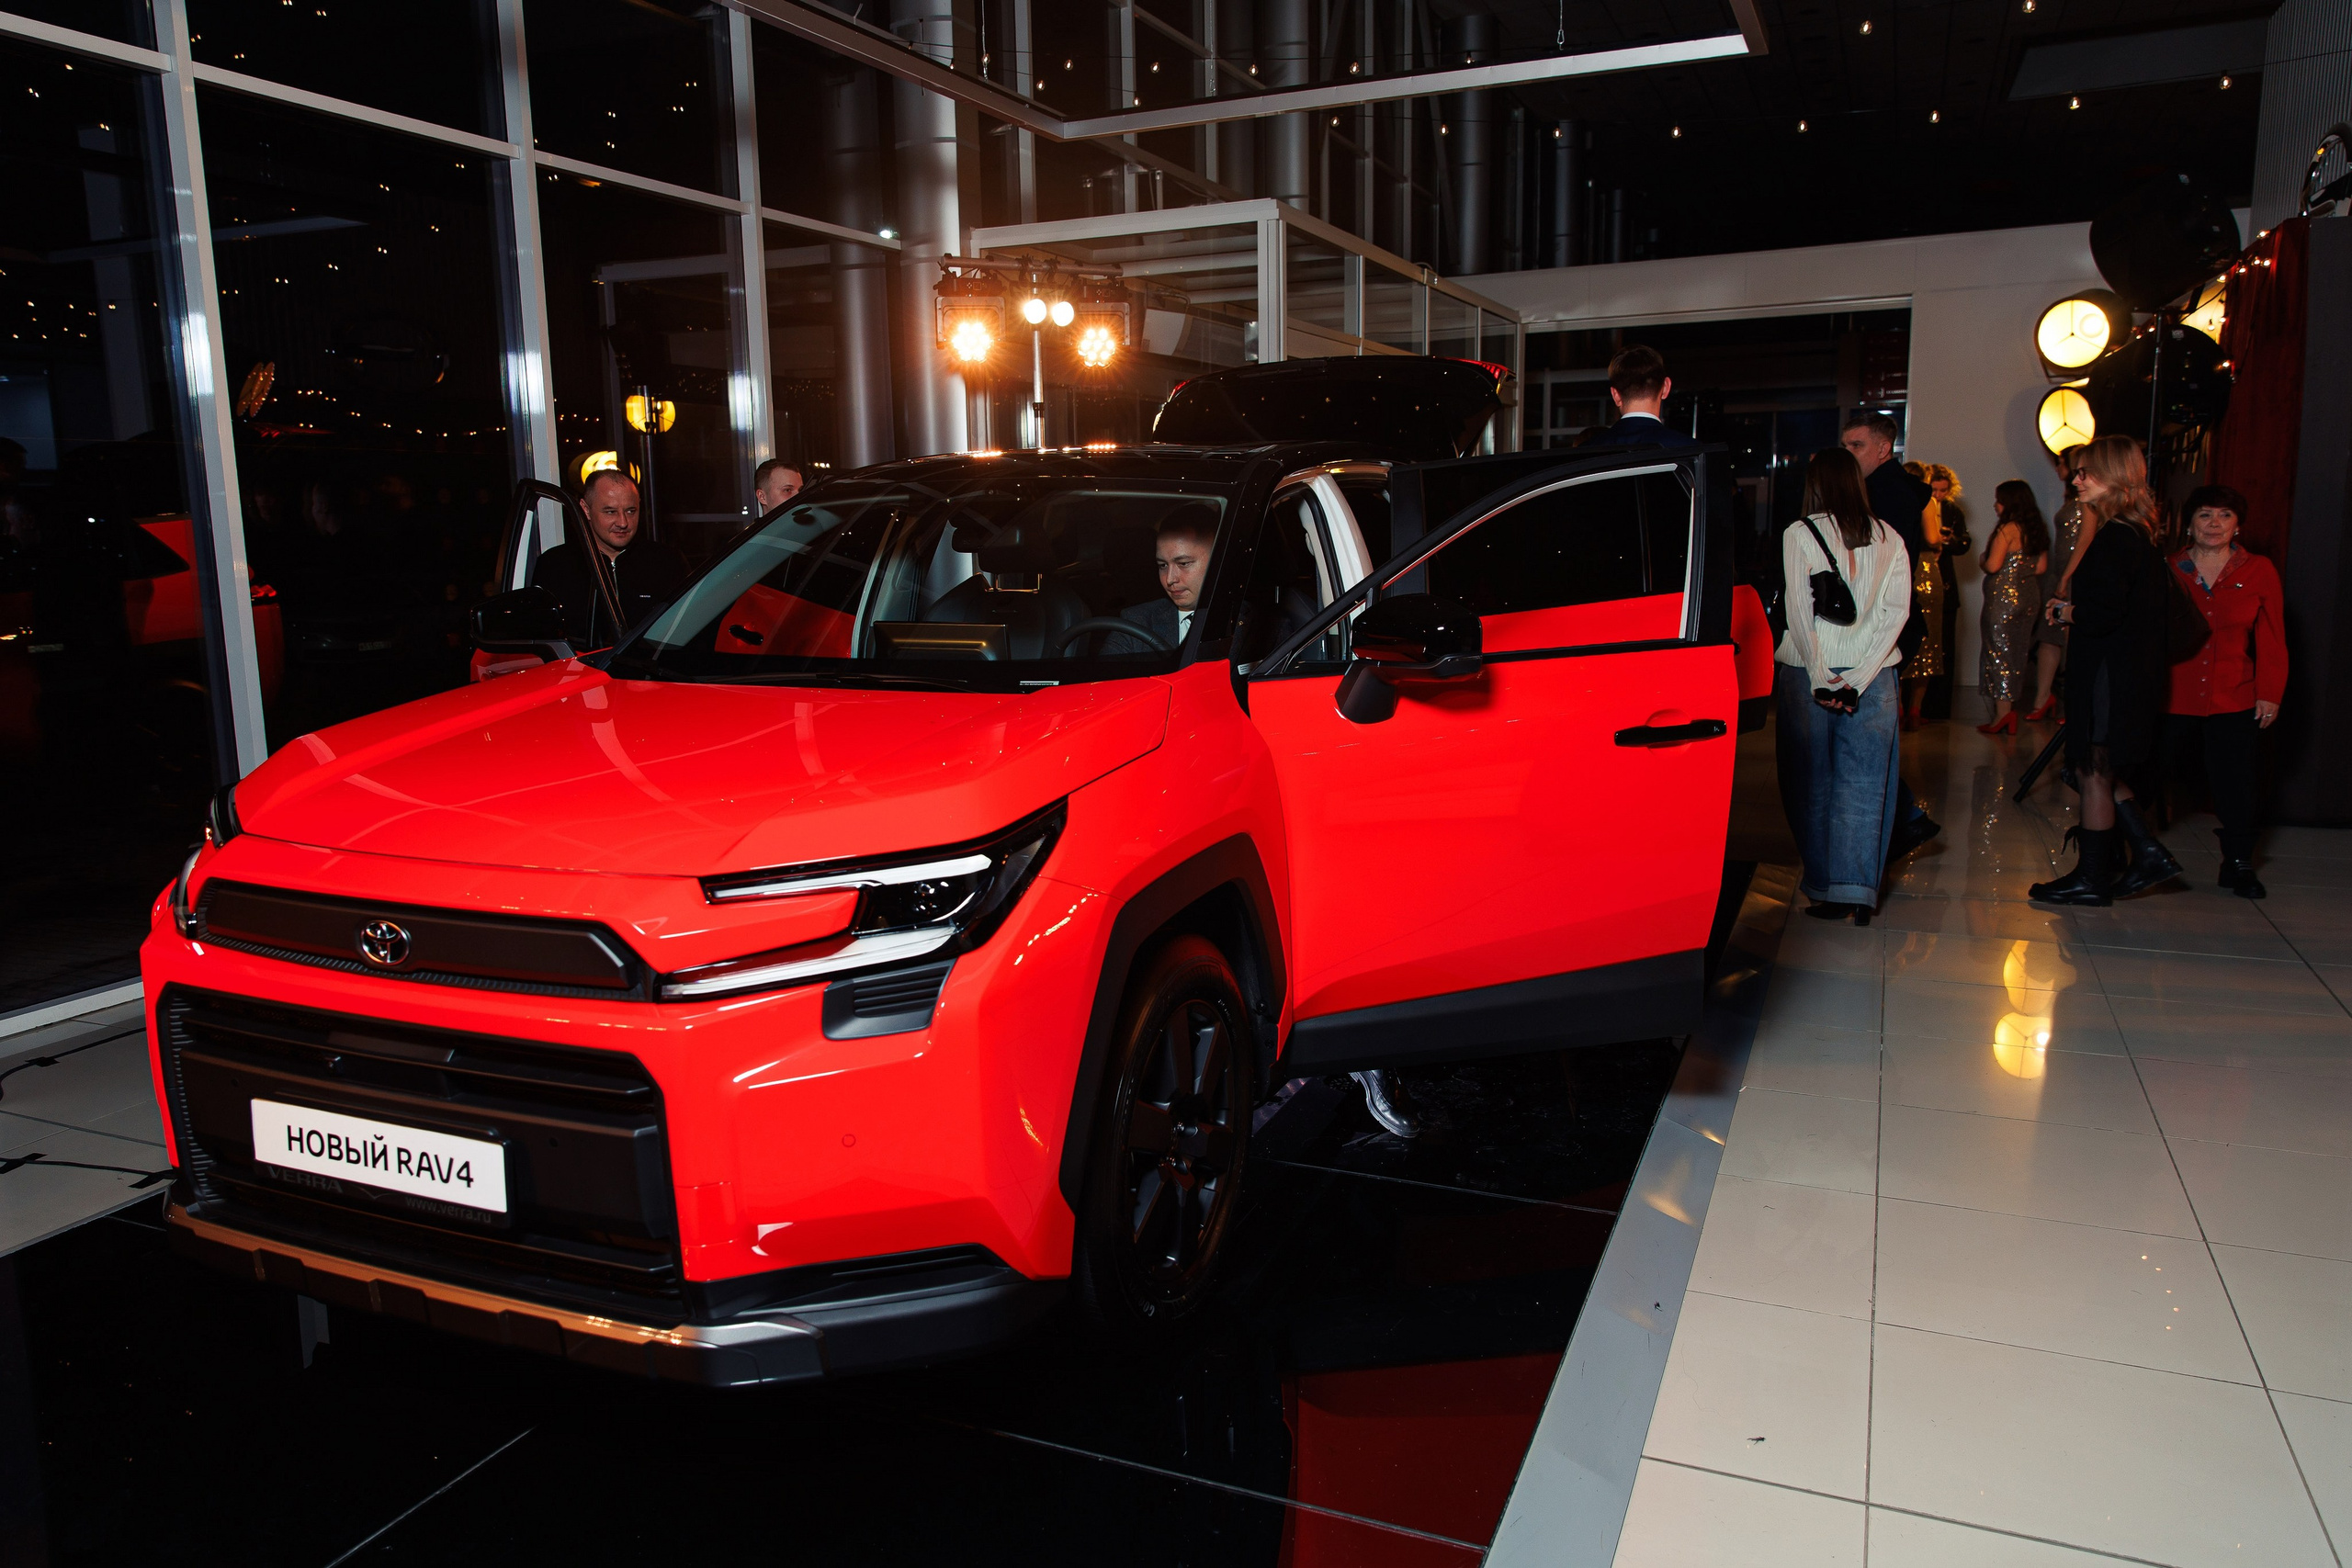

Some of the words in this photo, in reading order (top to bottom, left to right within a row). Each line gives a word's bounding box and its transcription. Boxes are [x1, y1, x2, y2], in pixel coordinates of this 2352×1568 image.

[287, 1124, 389, 1171] НОВЫЙ
[397, 1146, 474, 1189] RAV4
[266, 1165, 344, 1194] VERRA
[404, 1195, 492, 1224] www.verra.ru
